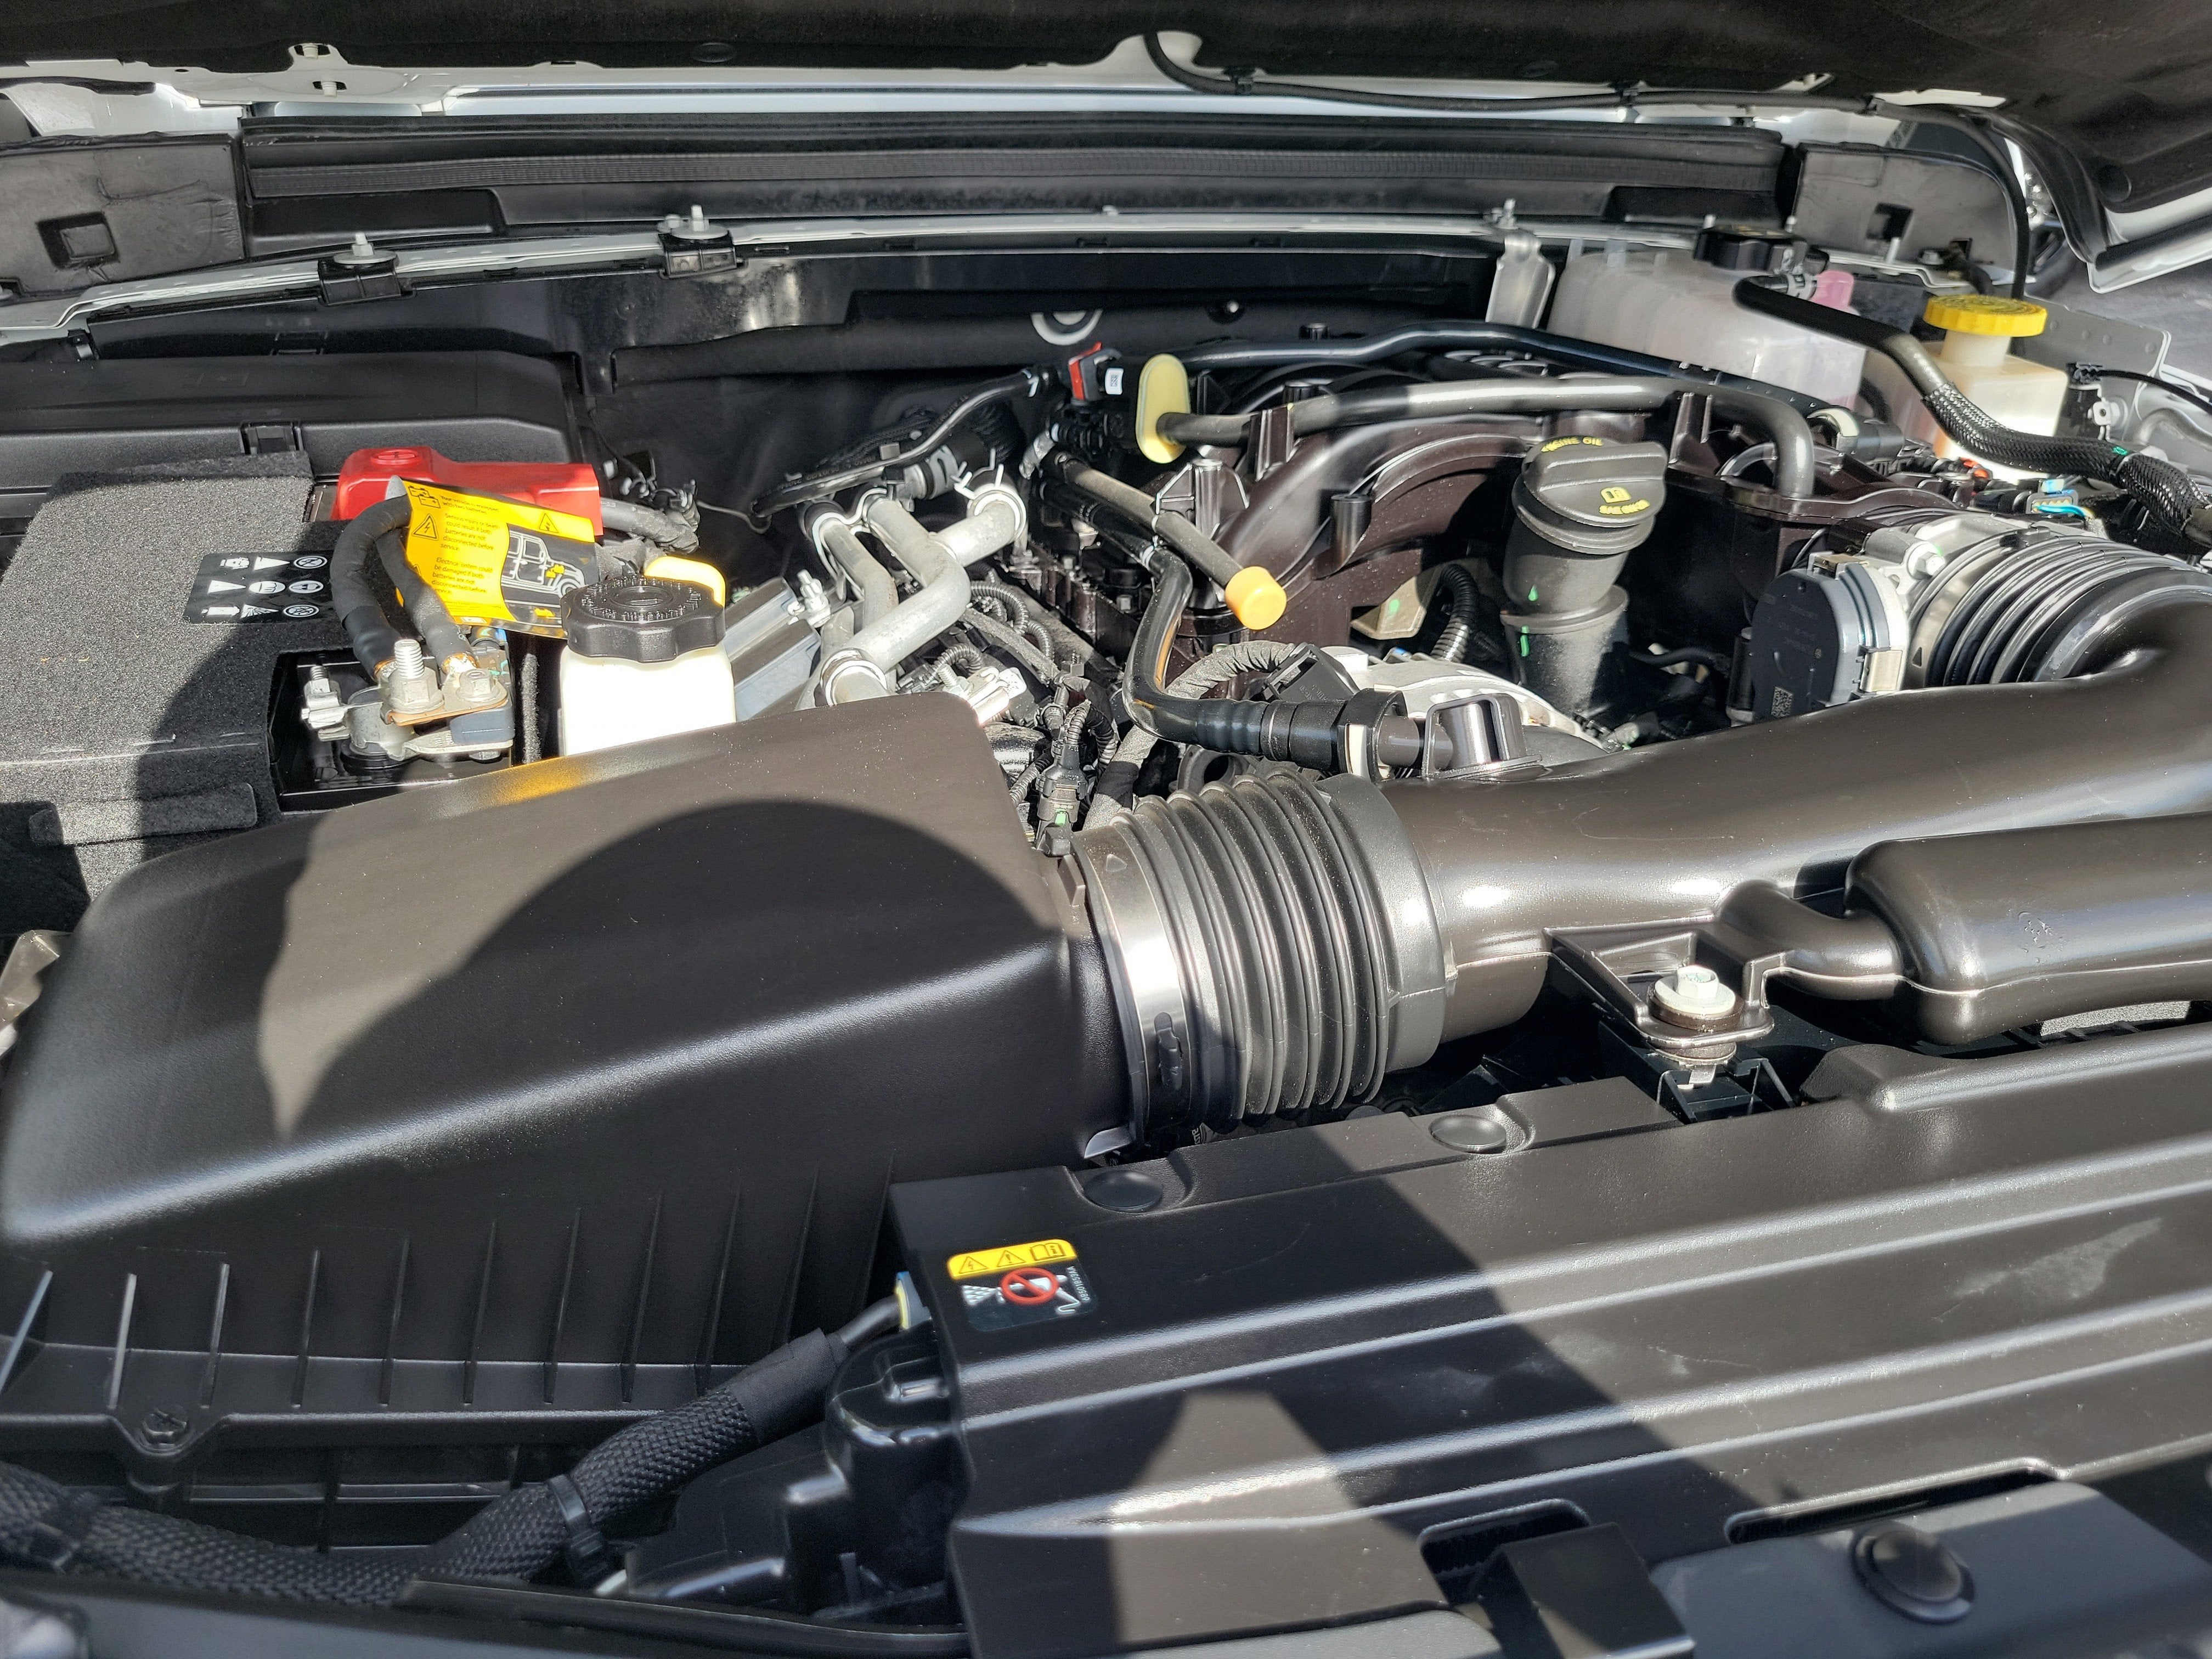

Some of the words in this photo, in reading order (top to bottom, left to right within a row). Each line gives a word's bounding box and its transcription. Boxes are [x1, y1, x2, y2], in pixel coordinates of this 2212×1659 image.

[1583, 437, 1603, 446] OIL
[445, 527, 467, 537] batteries
[443, 535, 477, 548] disconnected
[478, 541, 494, 550] before
[436, 557, 459, 566] Electrical
[1067, 1266, 1090, 1301] 68501853AA
